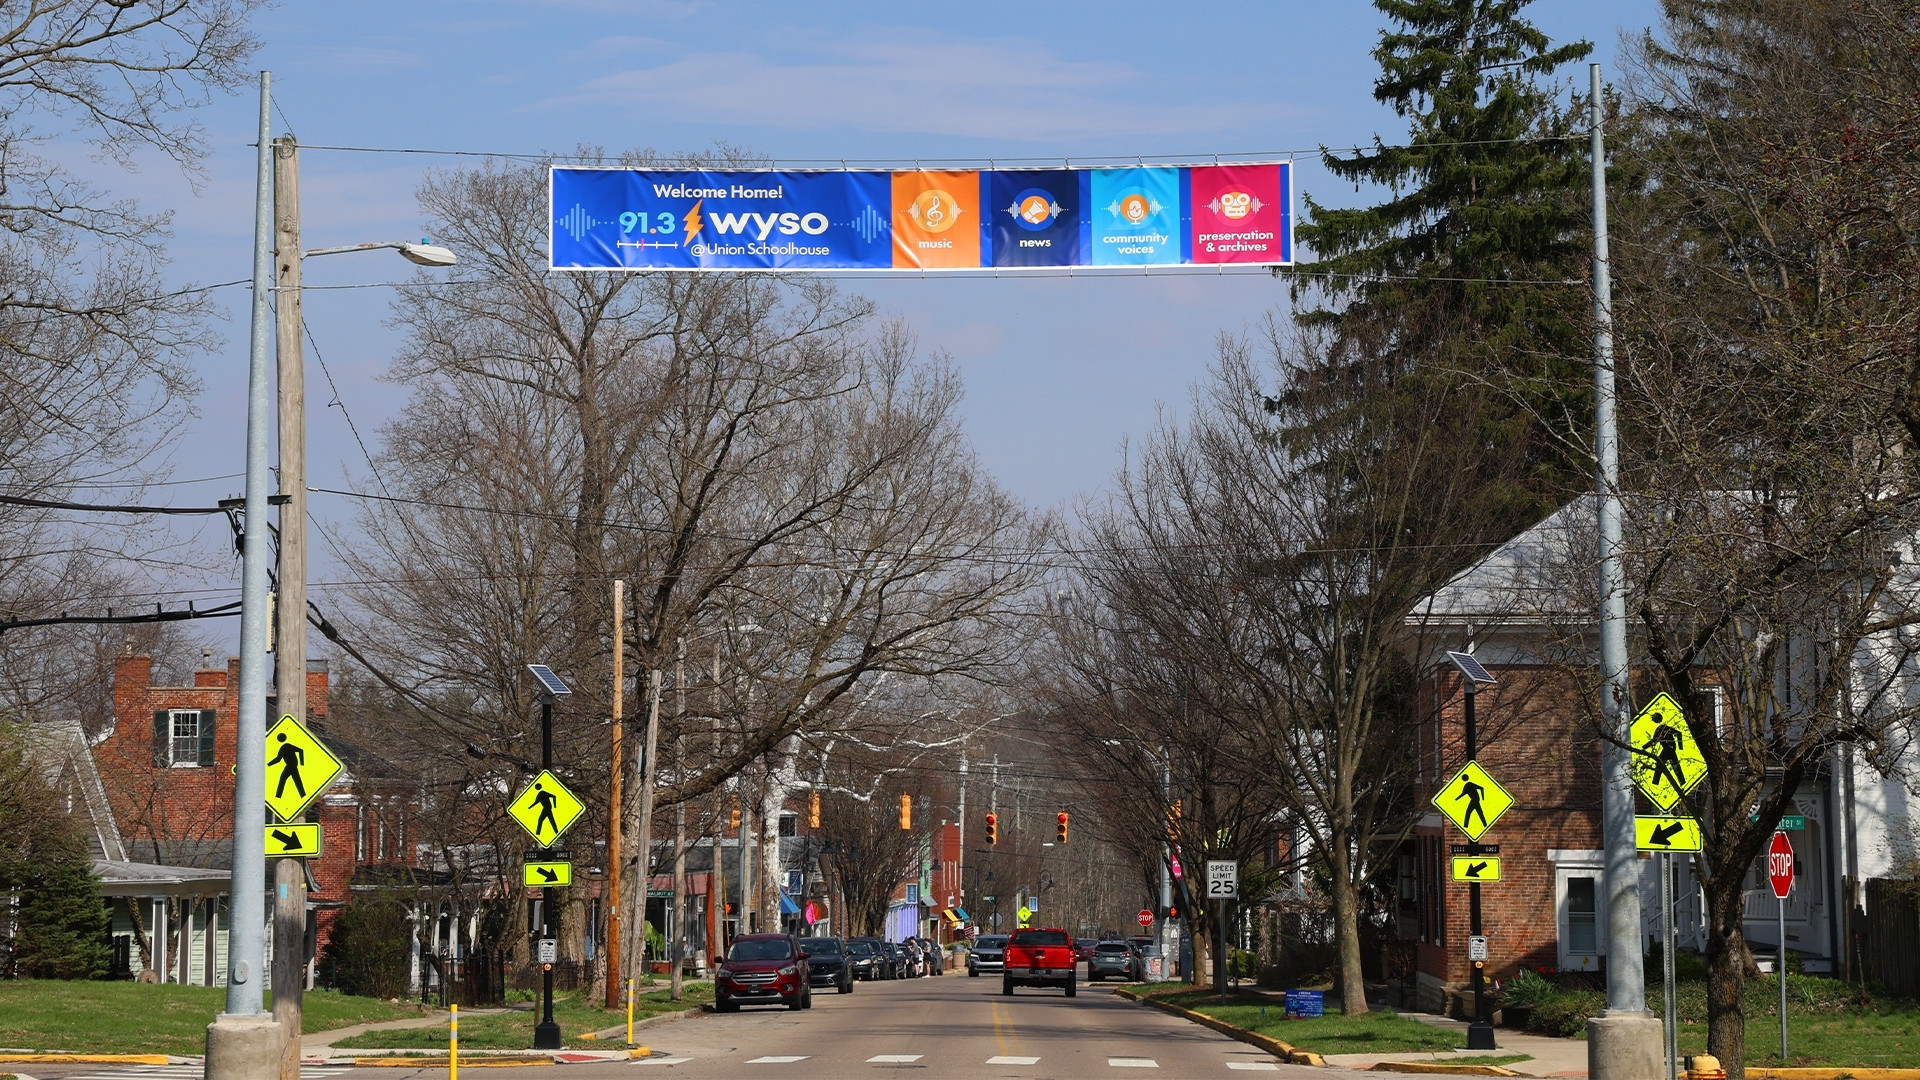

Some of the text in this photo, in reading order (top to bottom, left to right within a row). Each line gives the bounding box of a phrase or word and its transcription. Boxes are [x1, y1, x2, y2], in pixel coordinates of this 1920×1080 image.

[653, 183, 783, 198] Welcome Home!
[619, 211, 676, 235] 91.3
[918, 238, 953, 249] music
[1019, 239, 1051, 248] news
[1103, 233, 1168, 245] community
[1199, 230, 1274, 244] preservation
[690, 242, 830, 257] @ Union Schoolhouse
[1117, 244, 1155, 255] voices
[1205, 241, 1267, 253] & archives
[1770, 853, 1792, 876] STOP
[1210, 880, 1235, 894] 25
